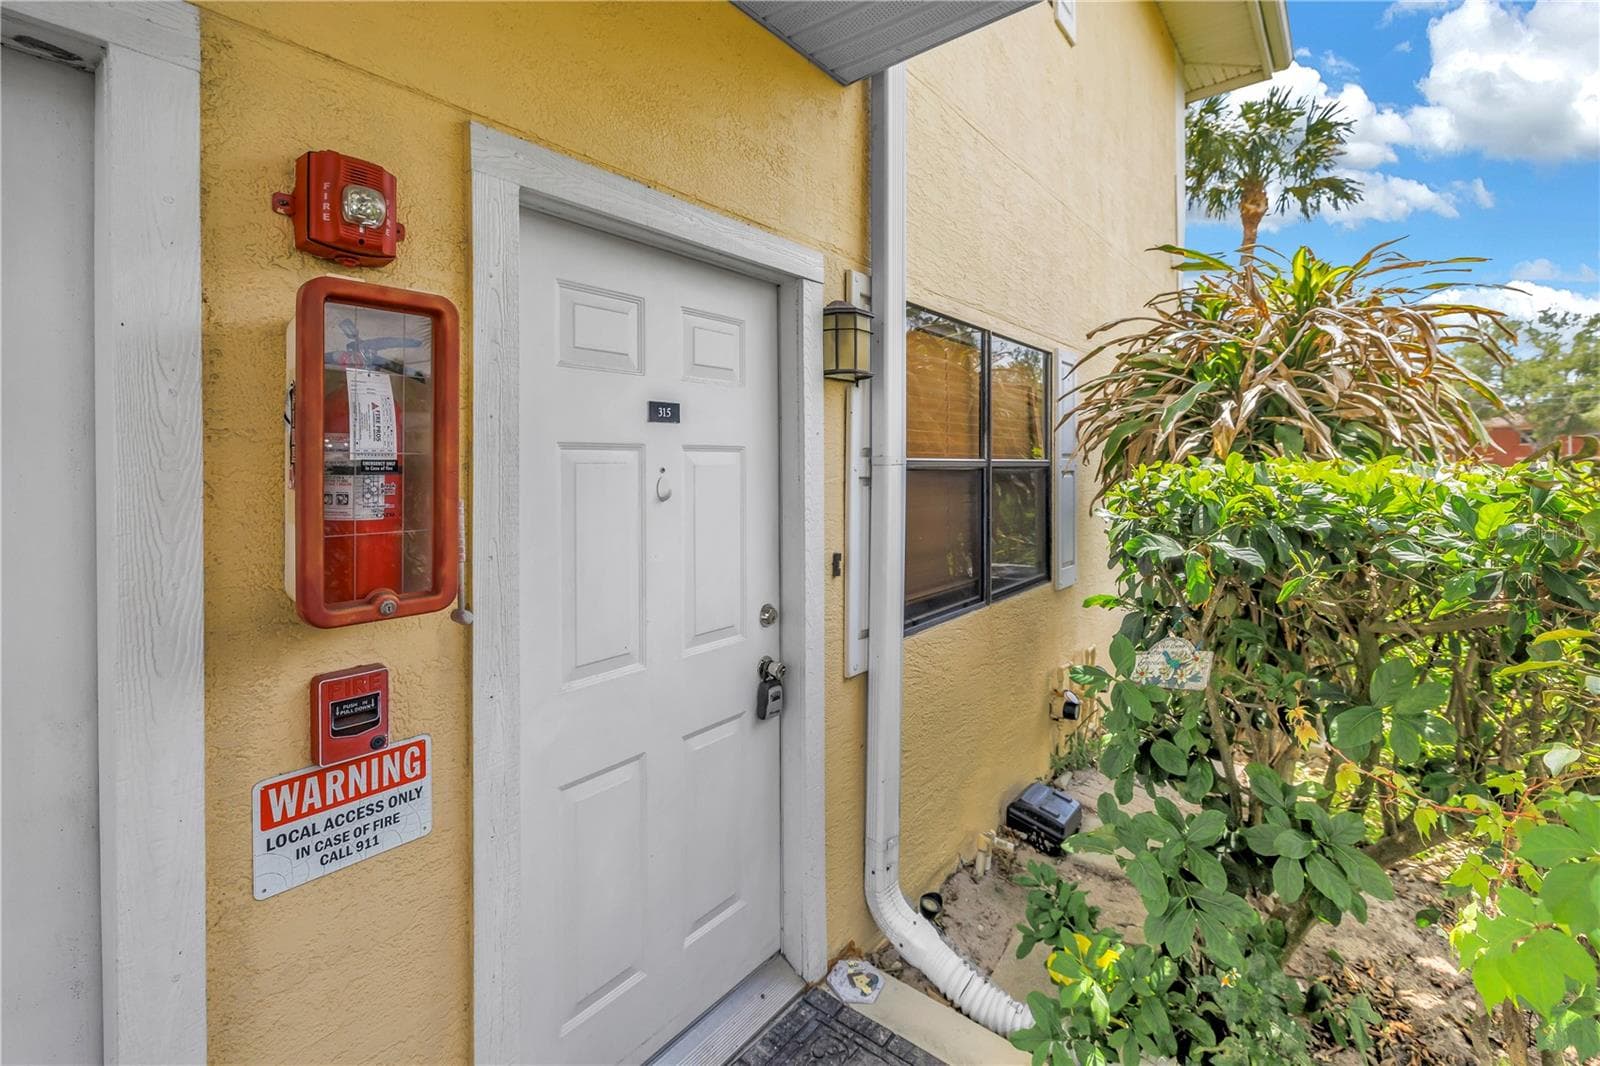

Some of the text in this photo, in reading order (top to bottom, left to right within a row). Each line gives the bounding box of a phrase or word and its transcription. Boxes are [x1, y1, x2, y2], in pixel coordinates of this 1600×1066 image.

[322, 182, 331, 221] FIRE
[657, 407, 672, 418] 315
[328, 673, 382, 698] FIRE
[354, 704, 371, 712] DOWN
[267, 745, 422, 823] WARNING
[266, 786, 423, 852] LOCAL ACCESS ONLY
[295, 812, 401, 860] IN CASE OF FIRE
[320, 834, 380, 866] CALL 911
